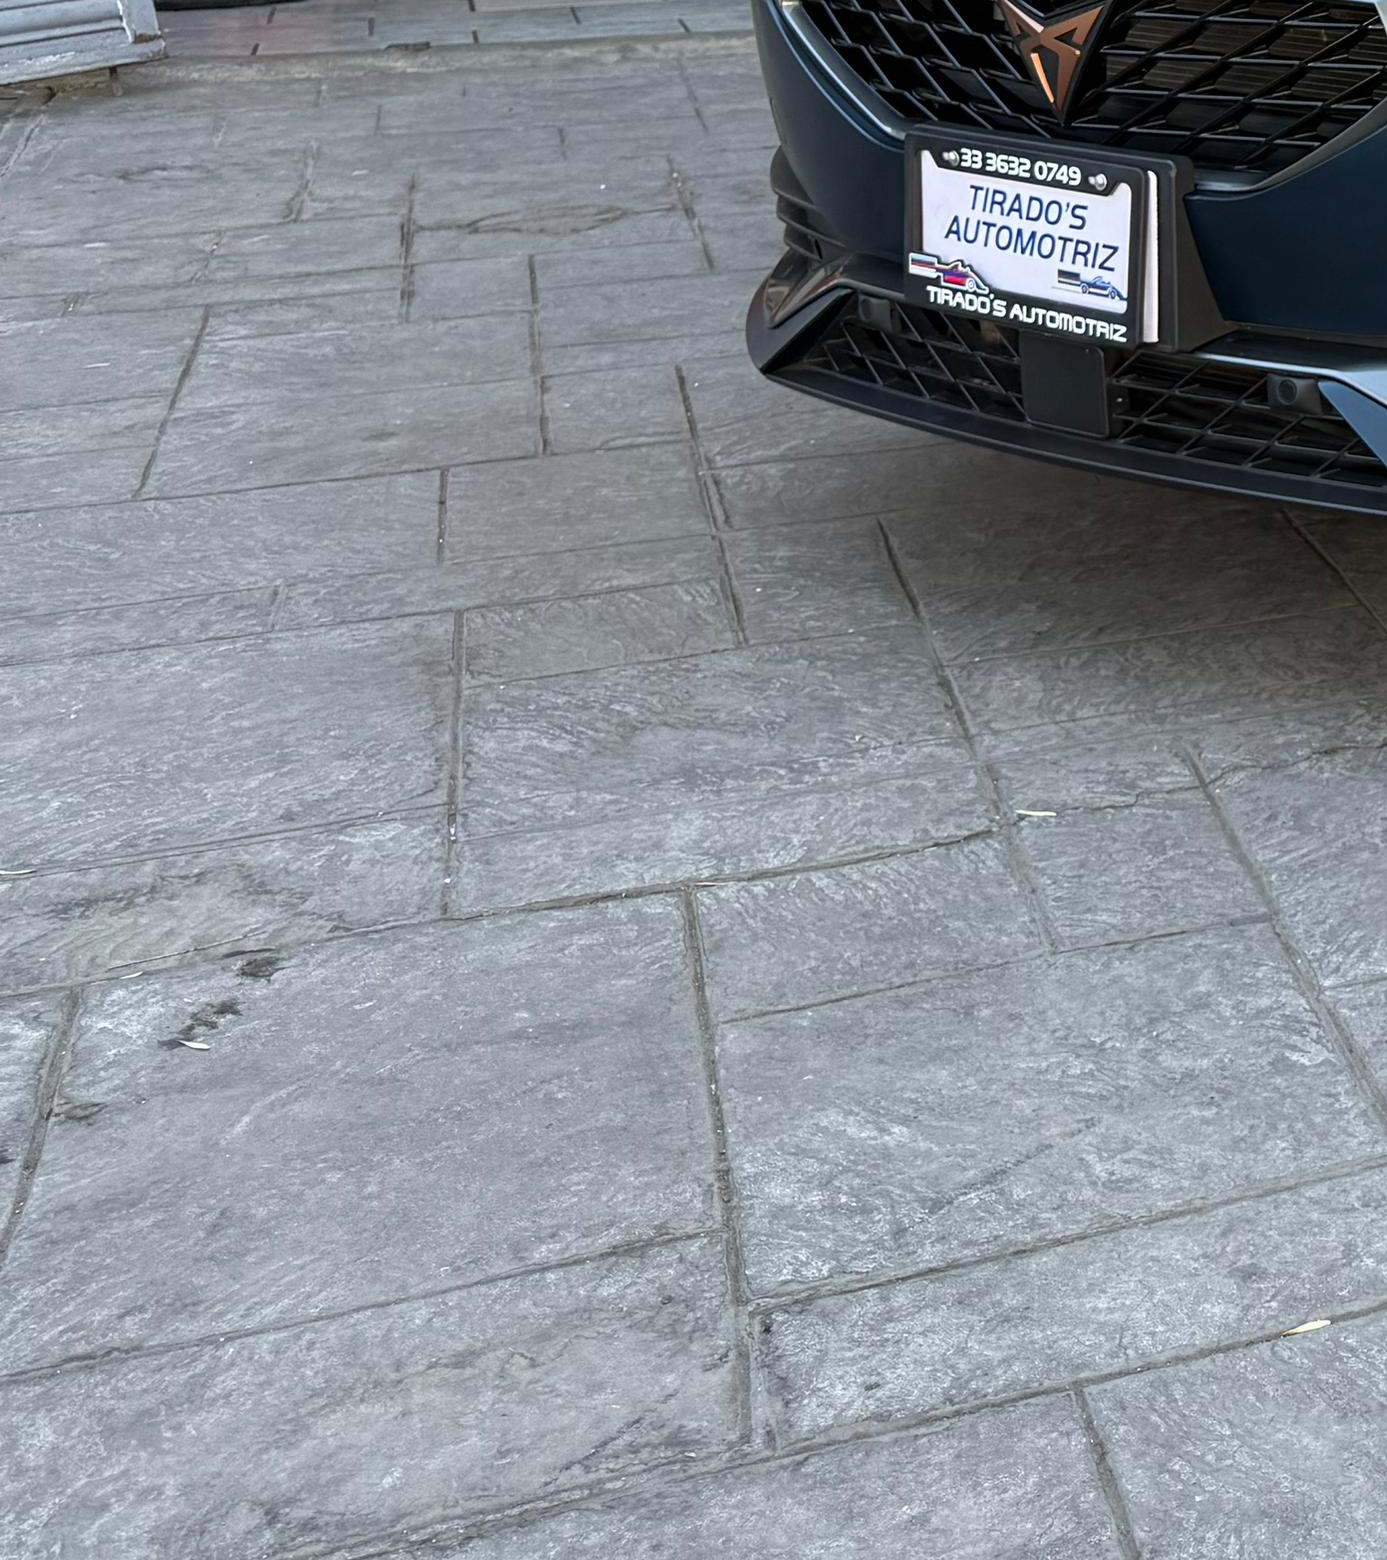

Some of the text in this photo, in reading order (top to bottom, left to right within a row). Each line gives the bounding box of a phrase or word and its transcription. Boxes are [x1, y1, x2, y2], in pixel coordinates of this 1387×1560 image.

[961, 147, 1082, 186] 33 3632 0749
[970, 185, 1088, 230] TIRADO'S
[944, 215, 1119, 272] AUTOMOTRIZ
[926, 285, 1128, 343] TIRADO'S AUTOMOTRIZ
